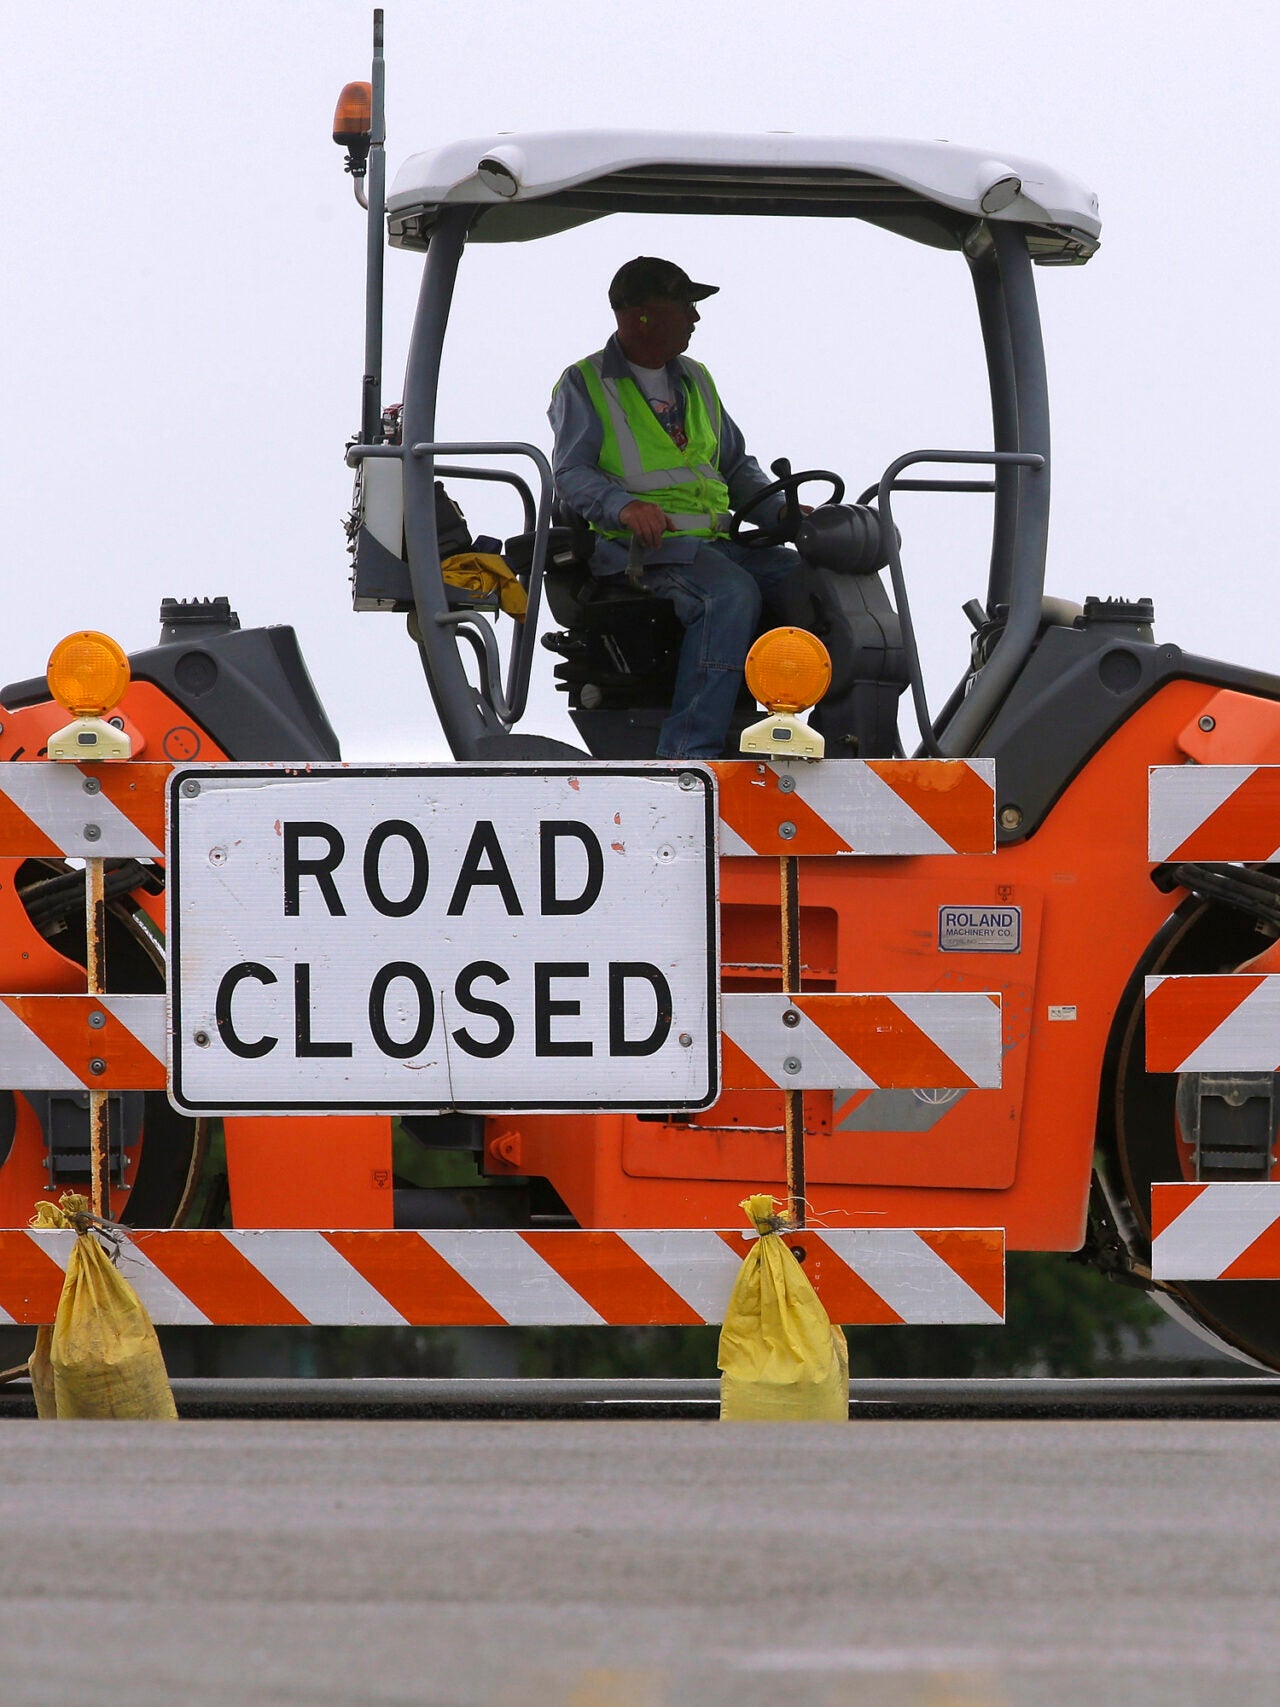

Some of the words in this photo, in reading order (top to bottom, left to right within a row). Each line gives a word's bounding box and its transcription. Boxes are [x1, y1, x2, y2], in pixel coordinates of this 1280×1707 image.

[283, 819, 604, 918] ROAD
[946, 913, 1013, 928] ROLAND
[946, 928, 995, 937] MACHINERY
[997, 929, 1013, 937] CO.
[215, 960, 673, 1059] CLOSED
